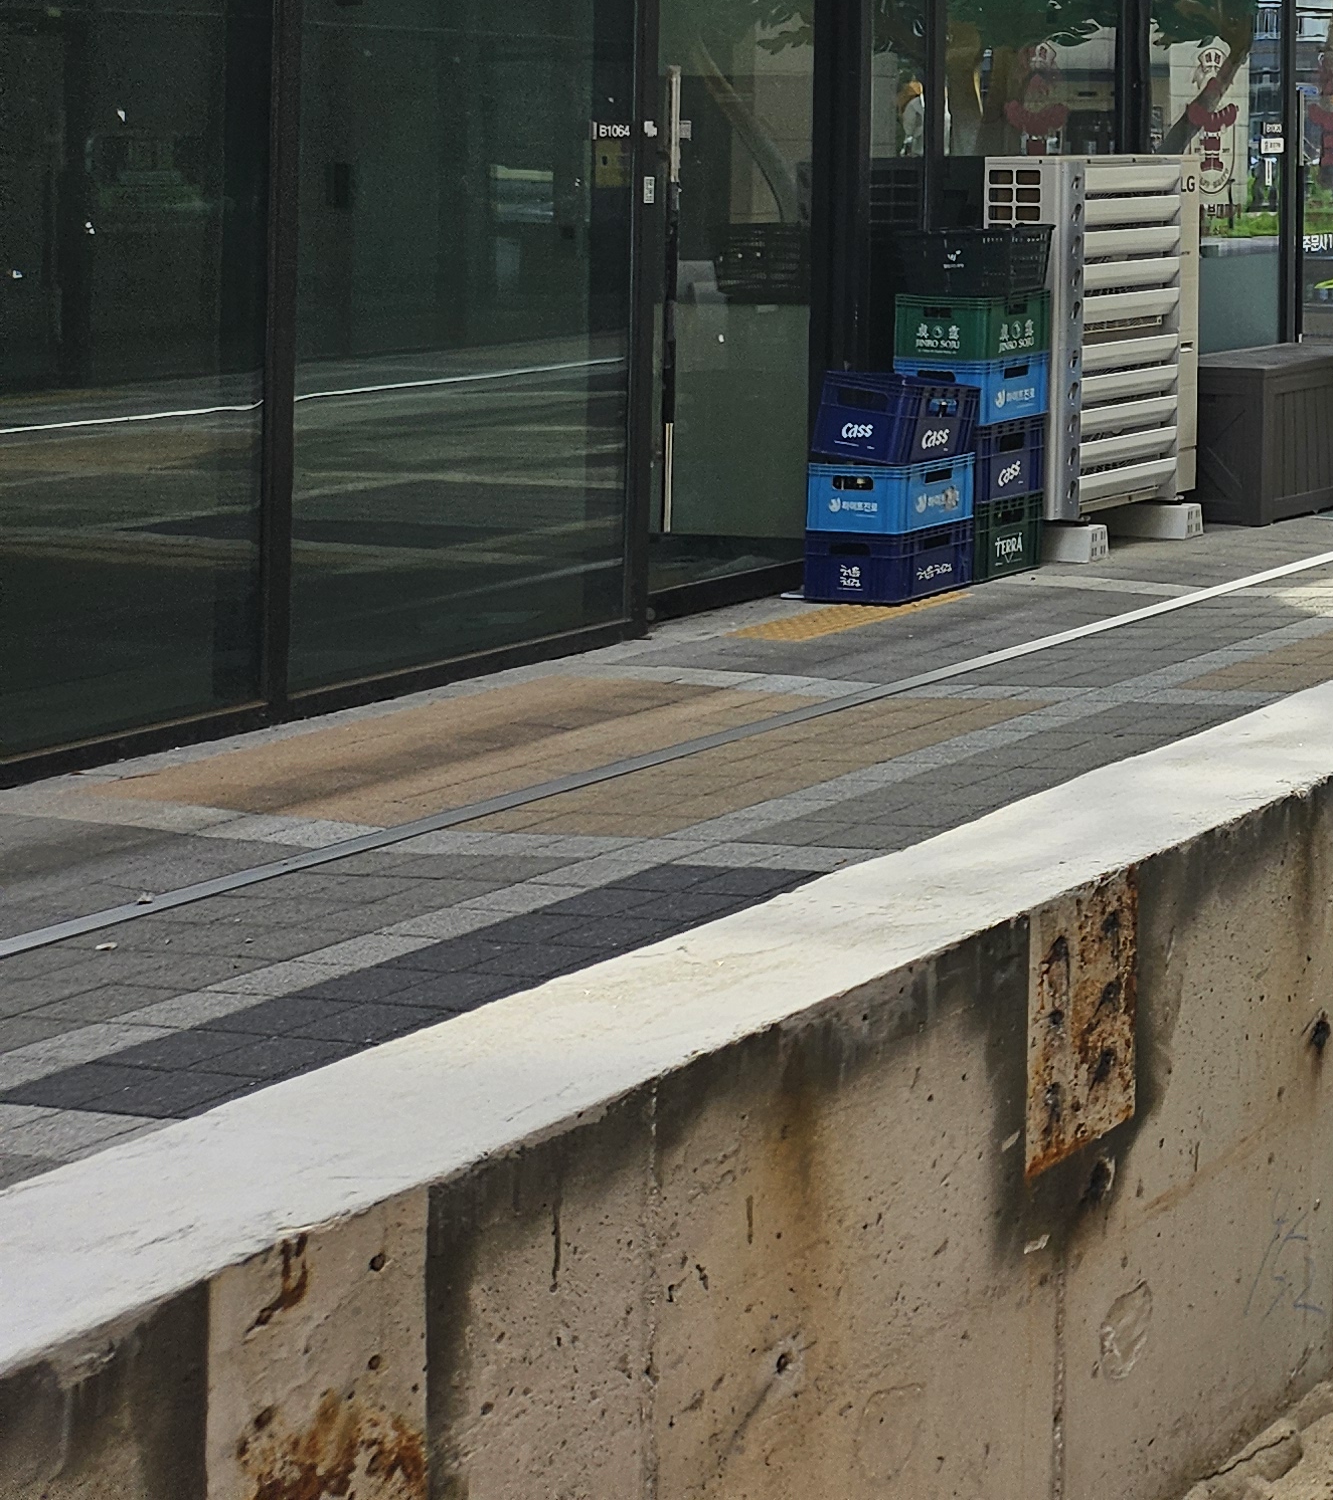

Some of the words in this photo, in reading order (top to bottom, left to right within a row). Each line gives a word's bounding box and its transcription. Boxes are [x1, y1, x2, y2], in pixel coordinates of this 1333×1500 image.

[599, 124, 630, 137] B1064
[1181, 176, 1195, 192] LG
[915, 339, 939, 348] JINRO
[998, 341, 1018, 353] JINRO
[841, 423, 873, 438] Cass
[922, 428, 950, 449] Cass
[998, 460, 1021, 487] Cass
[841, 500, 877, 512] 하이트진로
[995, 532, 1023, 558] TERRA
